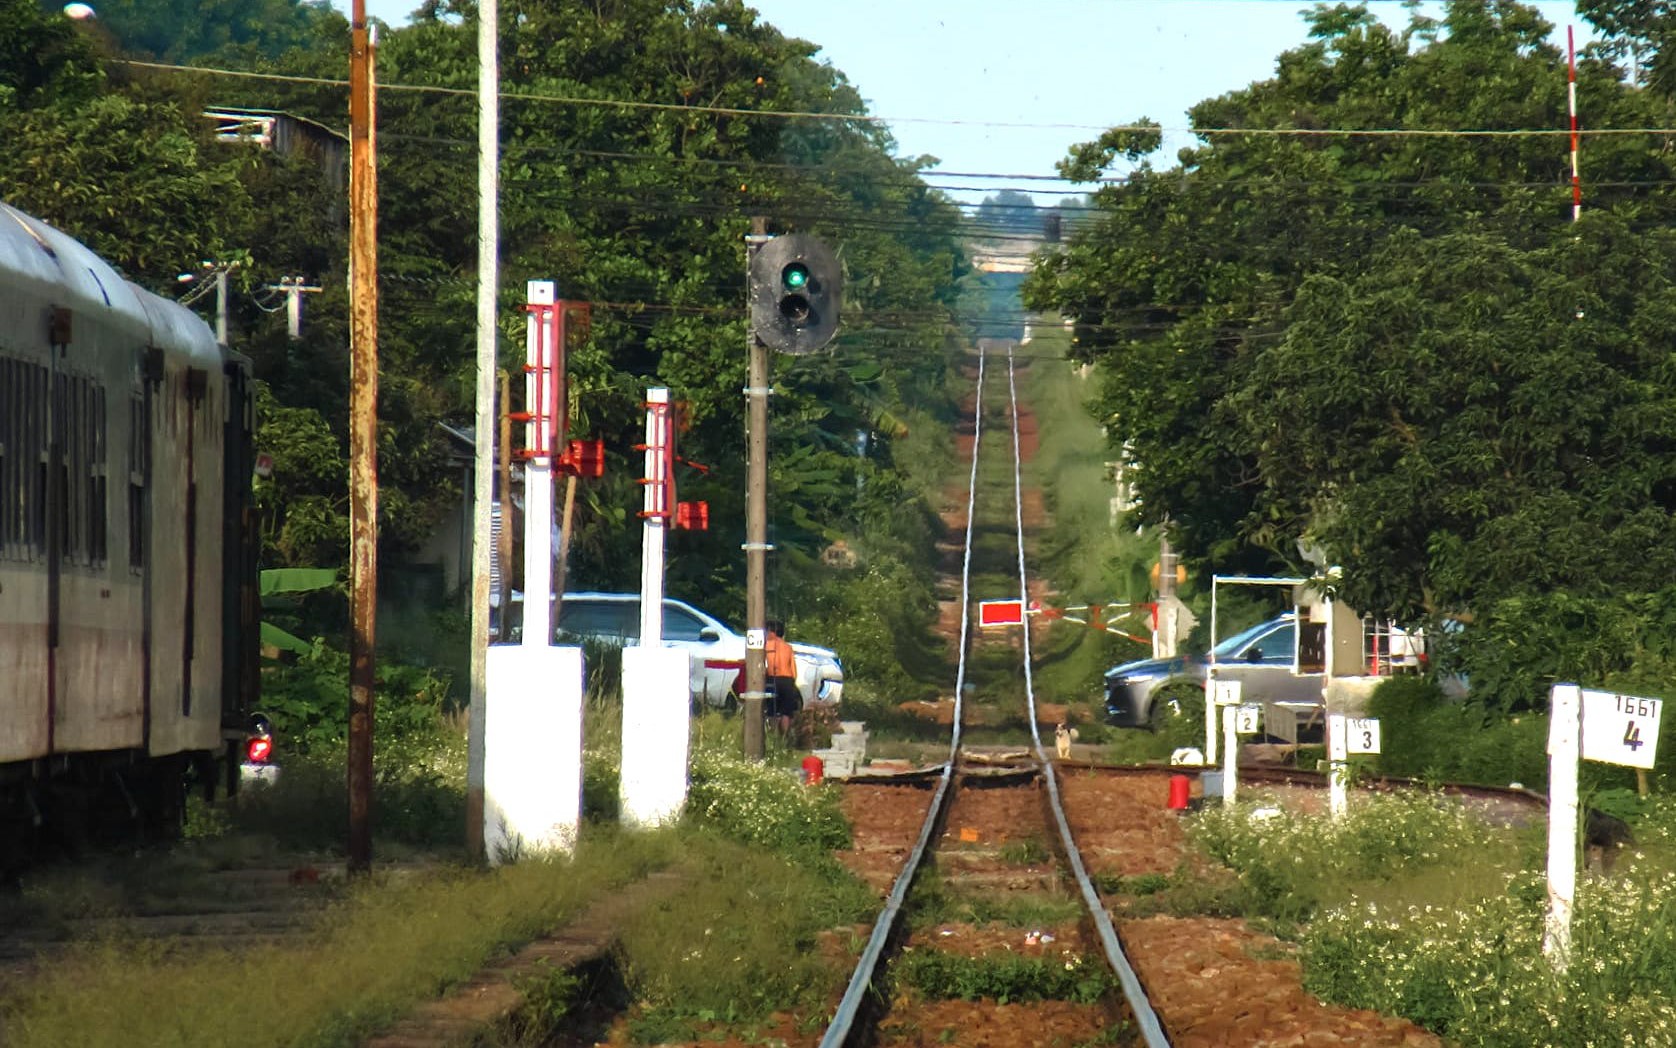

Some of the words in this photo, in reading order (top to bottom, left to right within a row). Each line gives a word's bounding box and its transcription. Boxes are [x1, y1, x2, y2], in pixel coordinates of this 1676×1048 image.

[1614, 695, 1656, 718] 1661
[1244, 717, 1251, 731] 2
[1363, 730, 1372, 749] 3
[1623, 720, 1644, 752] 4
